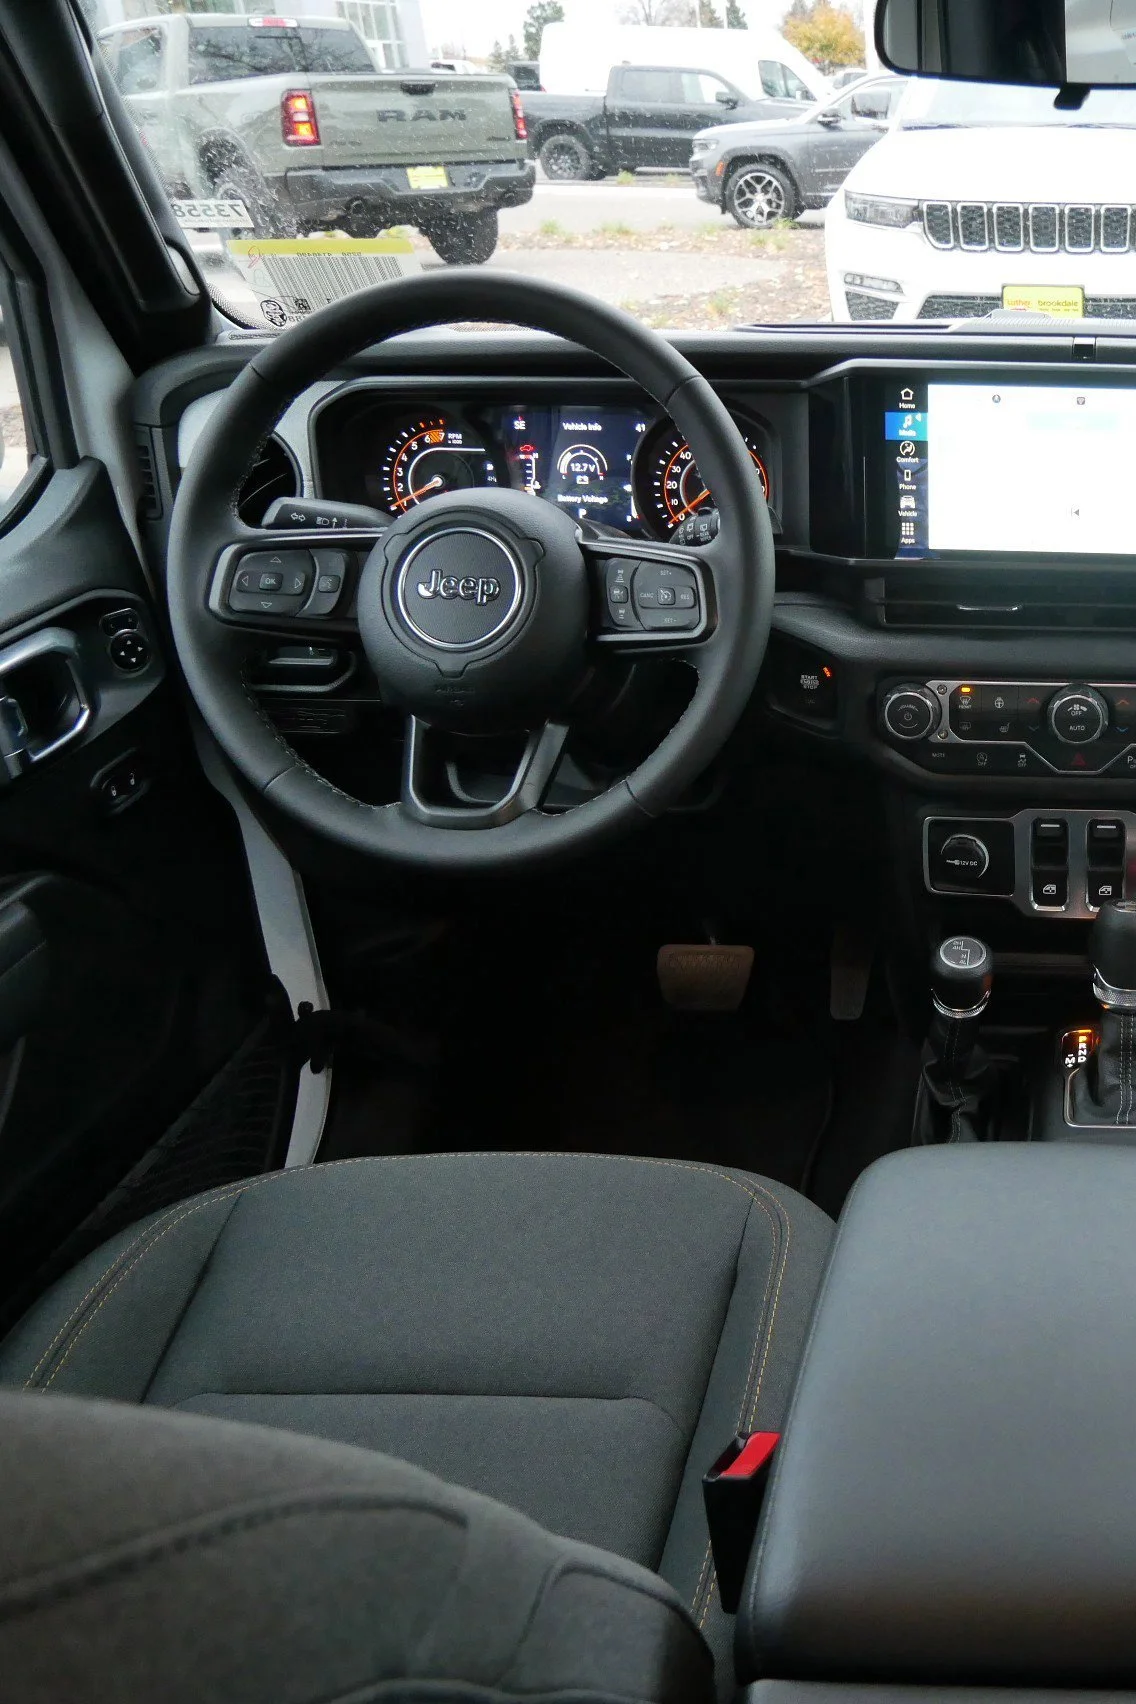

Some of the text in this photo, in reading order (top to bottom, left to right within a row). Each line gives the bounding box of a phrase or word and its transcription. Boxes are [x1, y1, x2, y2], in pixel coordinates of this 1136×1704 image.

[376, 109, 467, 122] RAM
[1037, 299, 1079, 307] brookdale
[514, 420, 526, 430] SE
[562, 422, 602, 431] Vehicle Info
[424, 435, 431, 443] 6
[438, 432, 445, 442] 7
[411, 441, 418, 450] 5
[401, 453, 408, 462] 4
[680, 452, 692, 460] 40
[396, 467, 403, 477] 3
[570, 463, 596, 472] 12.7 V
[397, 482, 404, 492] 2
[666, 481, 678, 490] 20
[557, 494, 609, 505] Battery Voltage
[679, 513, 685, 521] 0
[264, 577, 276, 585] OK
[417, 568, 501, 606] Jeep
